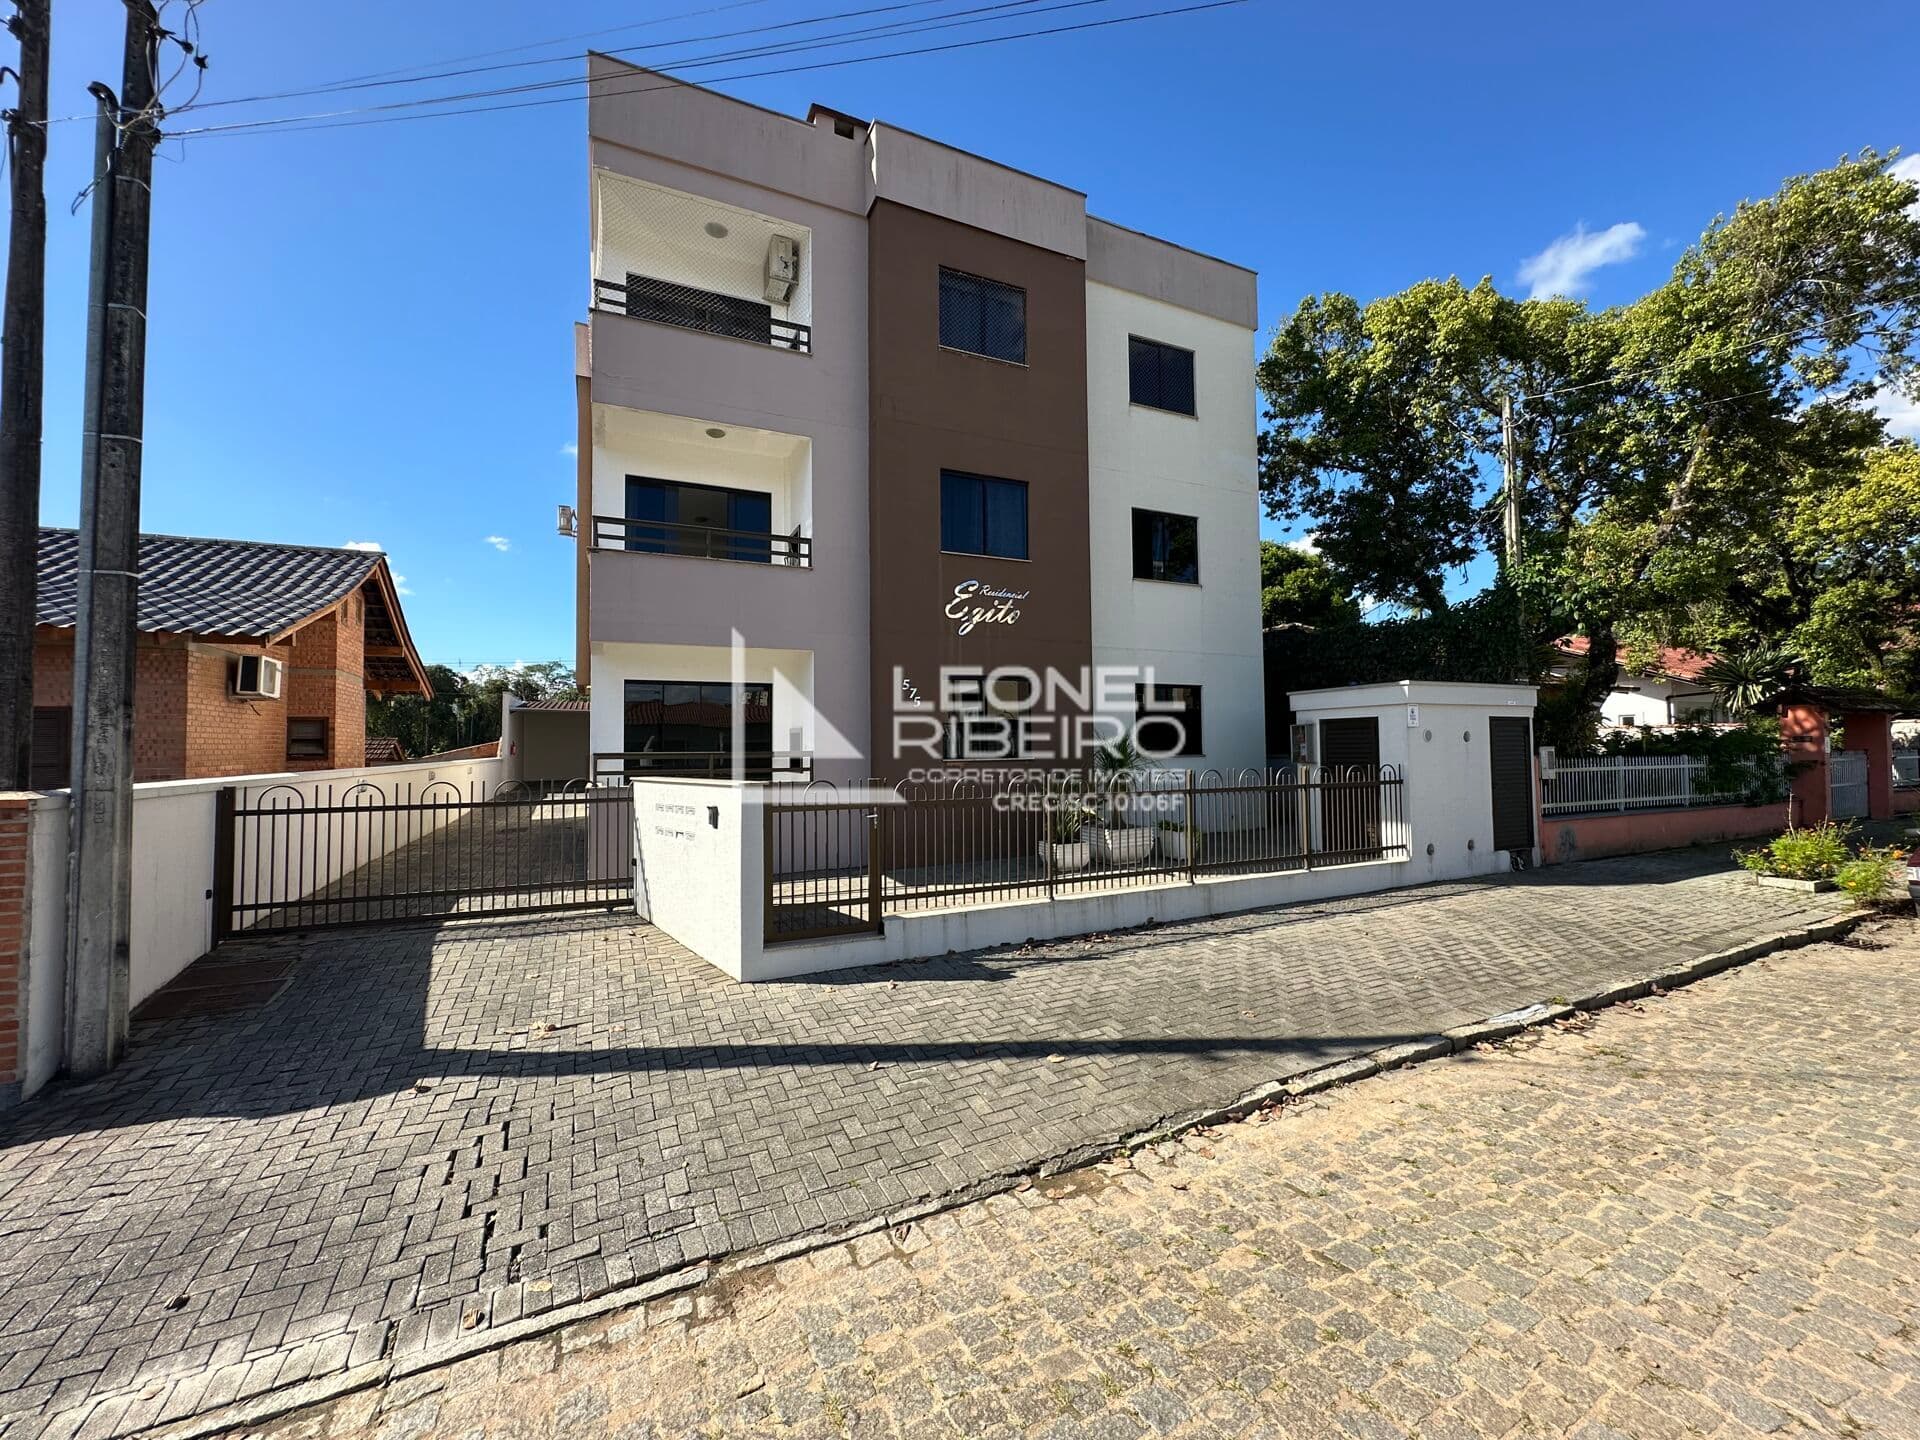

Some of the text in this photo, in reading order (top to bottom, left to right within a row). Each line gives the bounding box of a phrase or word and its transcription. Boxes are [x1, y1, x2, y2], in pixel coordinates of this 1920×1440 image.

[979, 584, 1030, 600] Residencial
[945, 580, 1021, 636] Egito
[902, 679, 921, 707] 575
